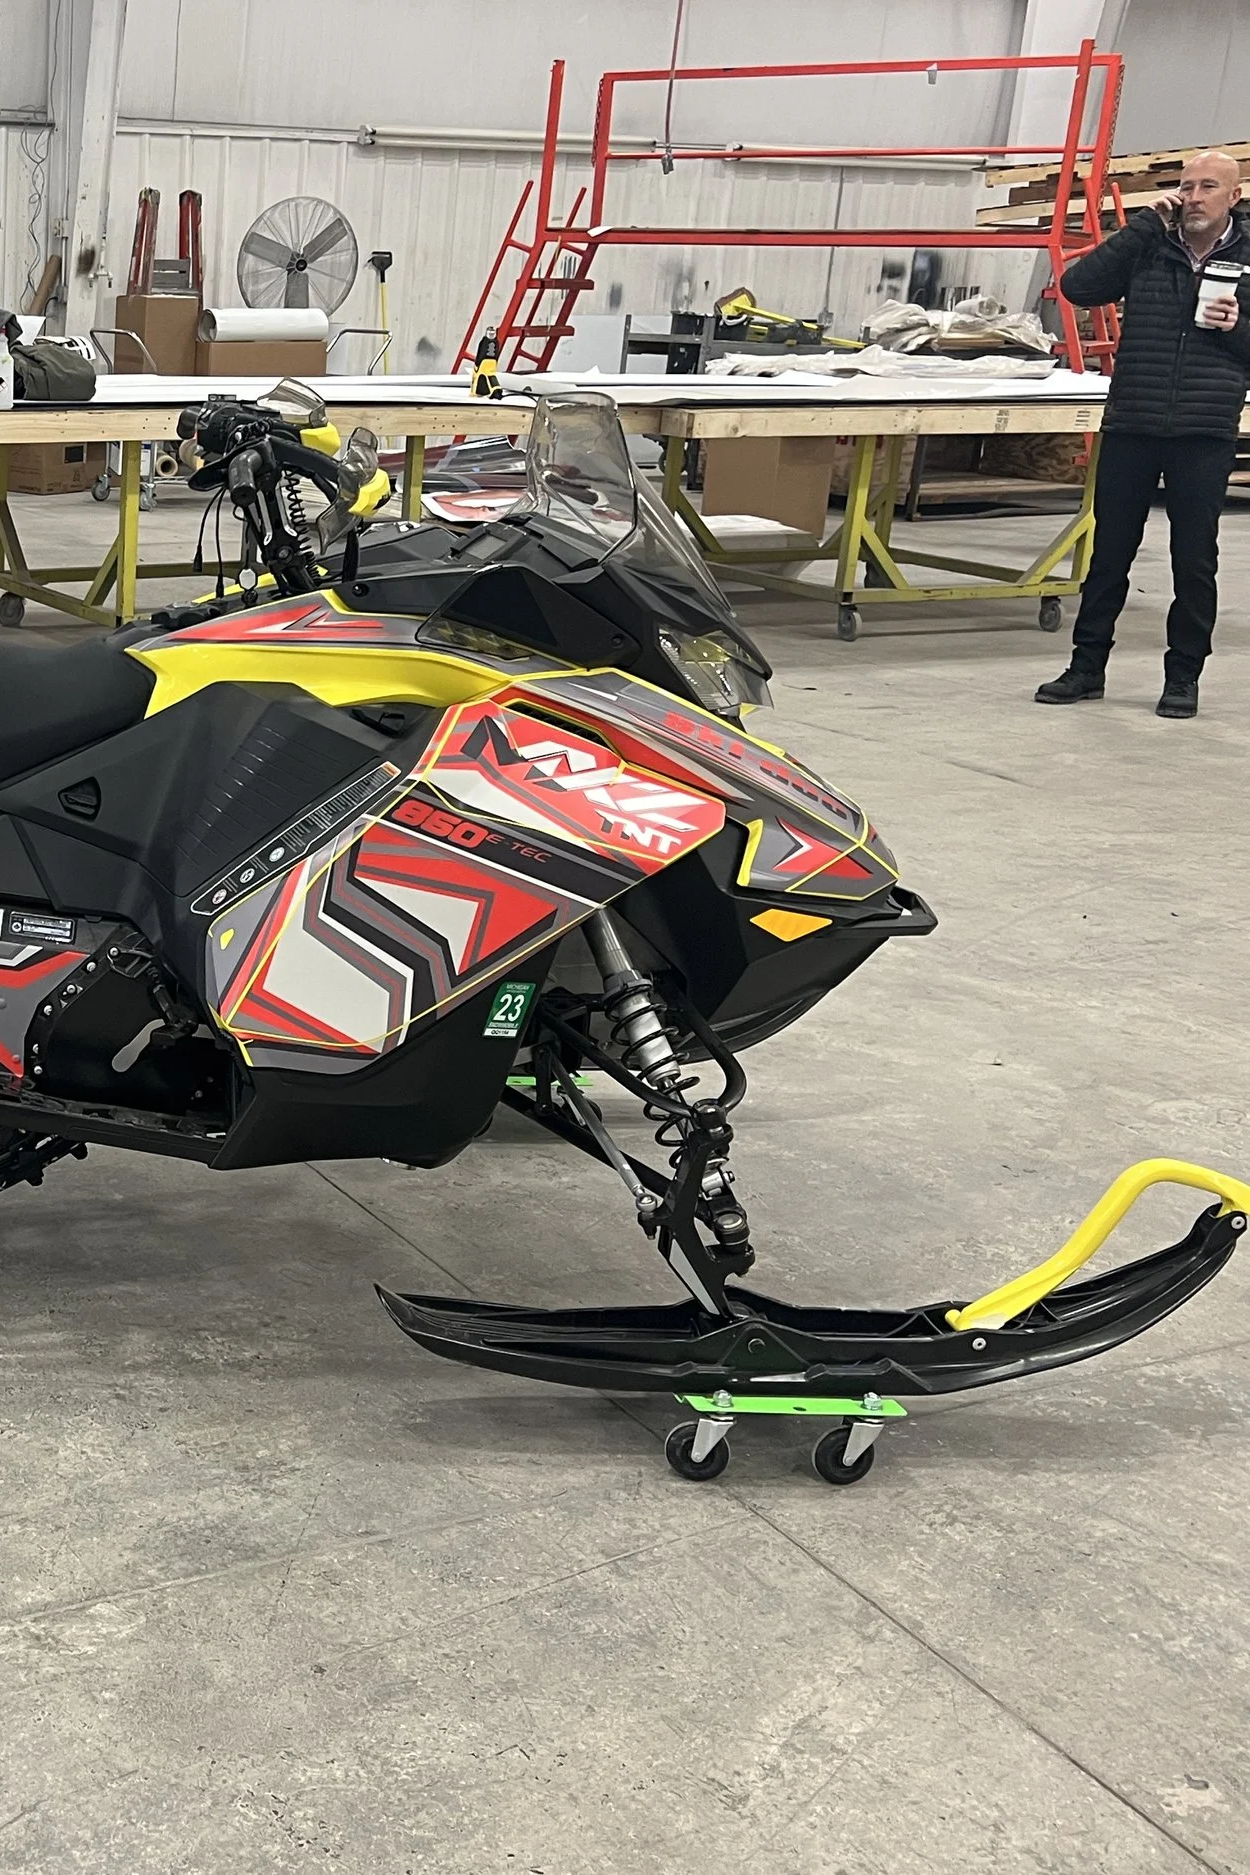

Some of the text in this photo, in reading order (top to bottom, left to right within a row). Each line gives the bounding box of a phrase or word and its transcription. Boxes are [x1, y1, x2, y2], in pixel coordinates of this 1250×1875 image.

[391, 799, 489, 849] 850
[594, 808, 682, 854] TNT
[493, 993, 525, 1022] 23
